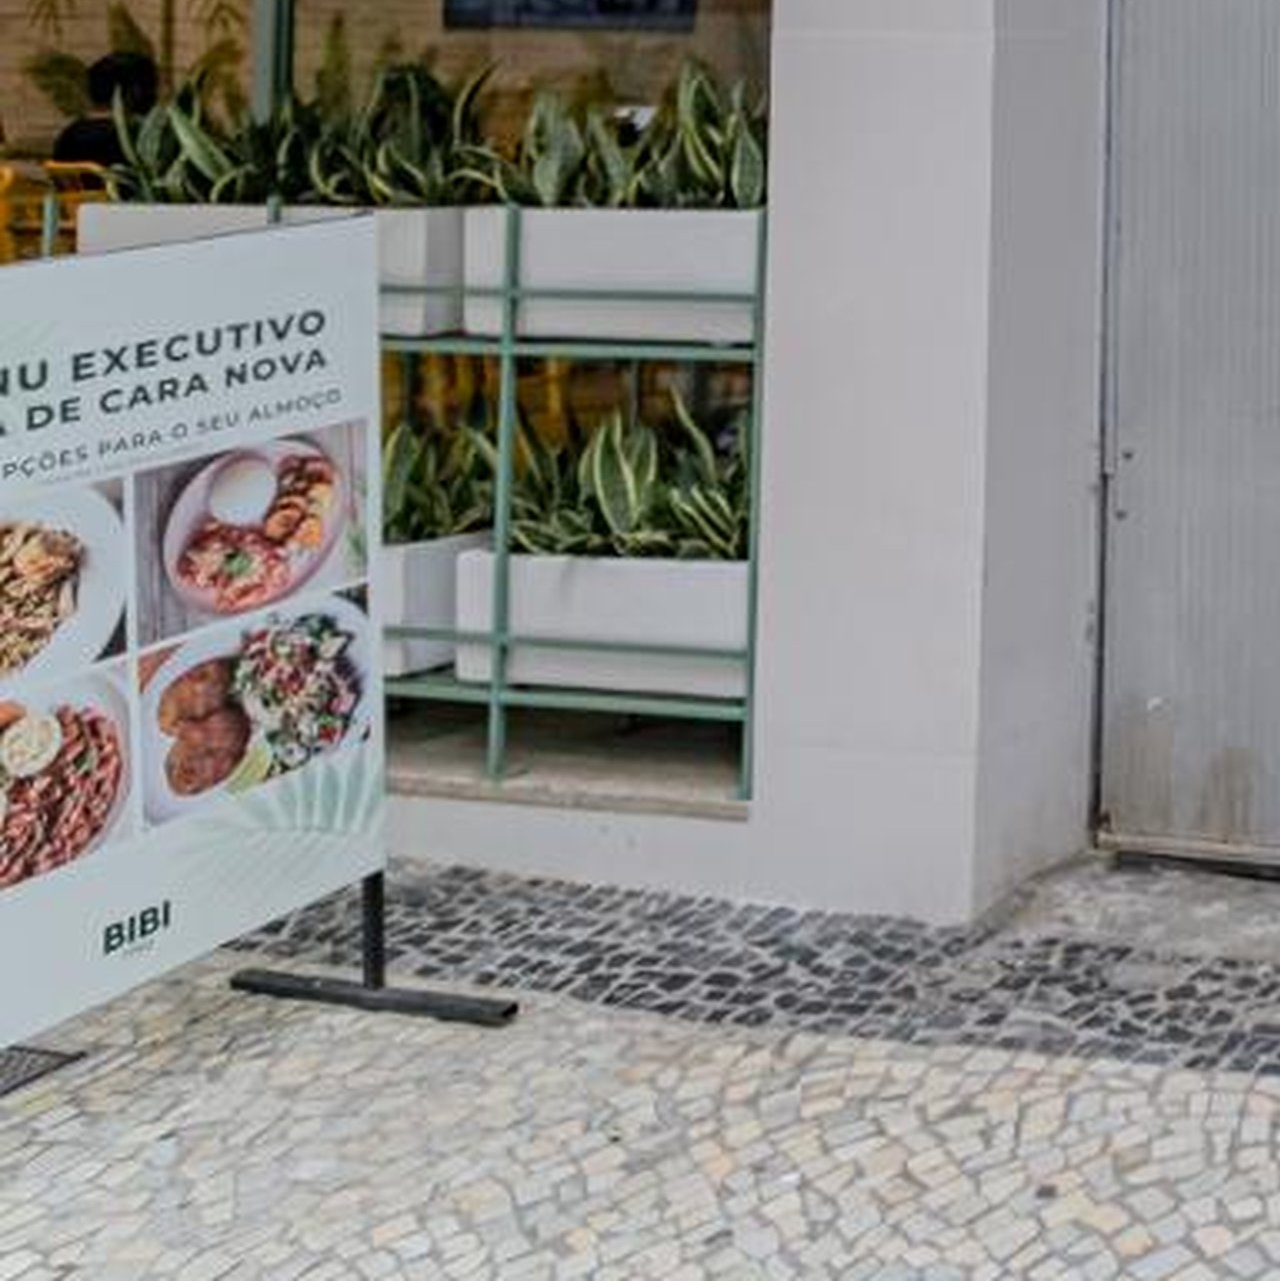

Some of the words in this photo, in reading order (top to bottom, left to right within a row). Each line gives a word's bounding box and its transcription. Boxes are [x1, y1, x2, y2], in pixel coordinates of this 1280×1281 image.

[71, 309, 326, 383] EXECUTIVO
[26, 395, 82, 431] DE
[98, 373, 210, 414] CARA
[224, 348, 327, 389] NOVA
[98, 429, 162, 456] PARA
[171, 421, 190, 440] O
[195, 411, 240, 435] SEU
[249, 387, 343, 422] ALMOÇO
[103, 898, 171, 956] BIBI
